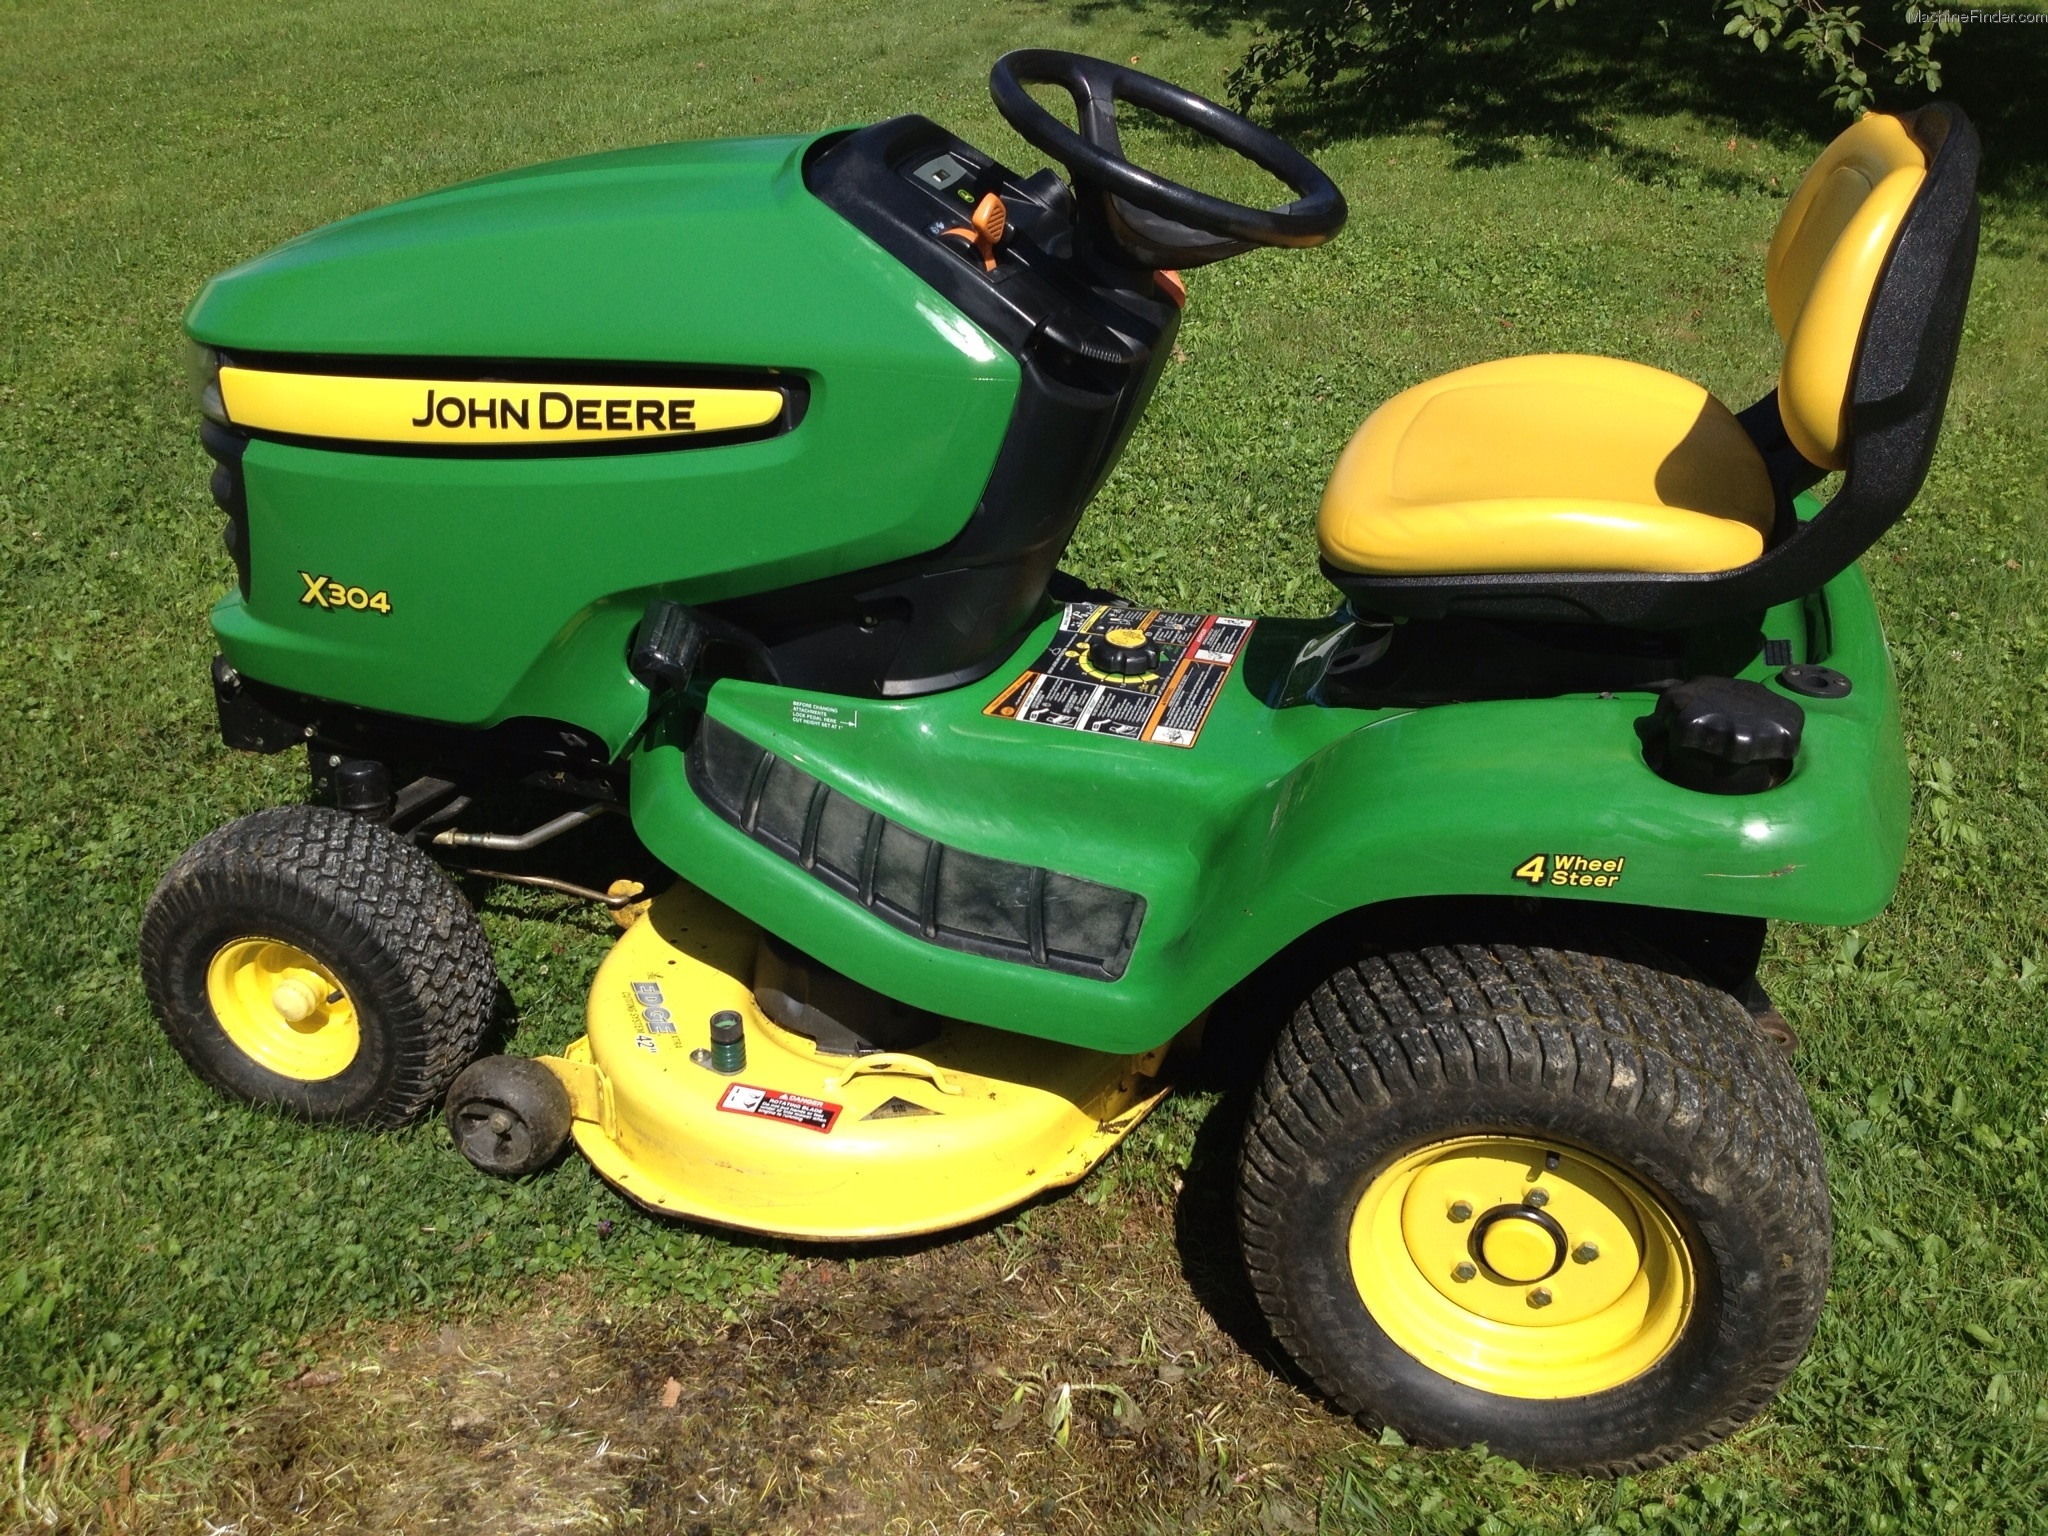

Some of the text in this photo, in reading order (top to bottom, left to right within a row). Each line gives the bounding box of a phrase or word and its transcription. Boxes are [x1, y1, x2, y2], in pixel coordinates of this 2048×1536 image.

[412, 389, 697, 432] JOHN DEERE
[299, 570, 393, 616] X304
[792, 700, 838, 714] BEFORE CHANGING
[792, 706, 827, 717] ATTACHMENTS
[806, 714, 822, 722] PEDAL
[1513, 853, 1548, 886] 4
[1554, 854, 1625, 873] Wheel
[1550, 869, 1620, 887] Steer
[630, 981, 677, 1034] EDGE
[768, 1098, 824, 1114] ROTATING BLADE
[788, 1094, 824, 1107] DANGER
